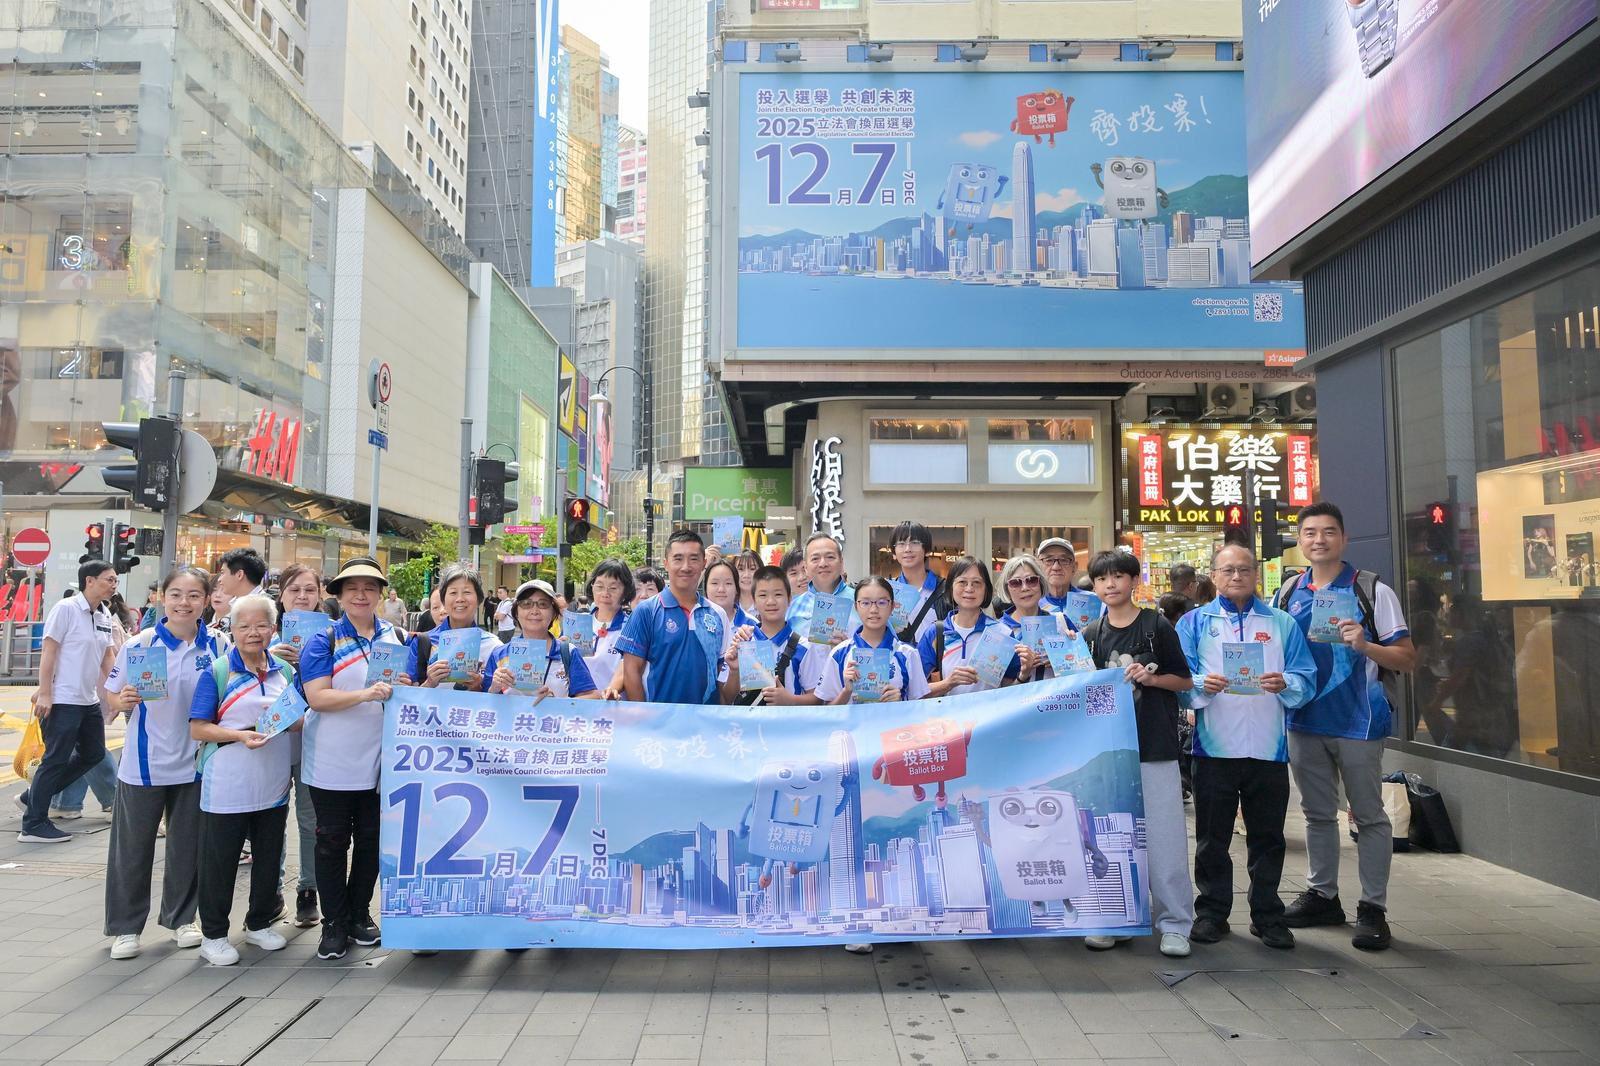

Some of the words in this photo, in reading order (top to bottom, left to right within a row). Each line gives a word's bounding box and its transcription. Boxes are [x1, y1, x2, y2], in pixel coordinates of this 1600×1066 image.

[757, 89, 829, 105] 投入選舉
[842, 89, 914, 105] 共創未來
[813, 106, 844, 114] Together
[757, 118, 816, 137] 2025
[817, 117, 914, 130] 立法會換屆選舉
[903, 170, 914, 180] 7
[904, 181, 915, 204] DEC
[1278, 354, 1305, 363] Asiar
[1120, 367, 1163, 380] Outdoor
[1163, 367, 1222, 380] Advertising
[249, 408, 300, 485] H&M
[1167, 433, 1282, 472] 伯樂
[1142, 440, 1159, 501] 政府註冊
[1171, 474, 1282, 507] 大藥行
[1140, 509, 1171, 522] PAK
[1177, 509, 1210, 522] LOK
[1045, 704, 1065, 712] 2891
[1066, 703, 1081, 711] 1001
[398, 704, 498, 730] 投入選舉
[514, 713, 614, 735] 共創未來
[396, 727, 417, 738] Join
[418, 728, 435, 738] the
[435, 729, 470, 739] Election
[471, 730, 514, 744] Together
[515, 734, 530, 743] We
[531, 735, 562, 744] Create
[563, 735, 579, 744] the
[580, 735, 612, 744] Future
[393, 744, 475, 774] 2025
[475, 746, 608, 766] 立法會換屆選舉
[903, 743, 949, 767] 投票箱
[476, 766, 513, 776] Legislative
[513, 766, 542, 776] Council
[543, 766, 574, 776] General
[575, 766, 607, 775] Election
[909, 765, 930, 776] Ballot
[930, 763, 945, 774] Box
[592, 829, 606, 840] 7
[767, 826, 814, 848] 投票箱
[592, 842, 607, 880] DEC
[1016, 859, 1067, 878] 投票箱
[1023, 877, 1048, 887] Ballot
[1048, 877, 1064, 886] Box
